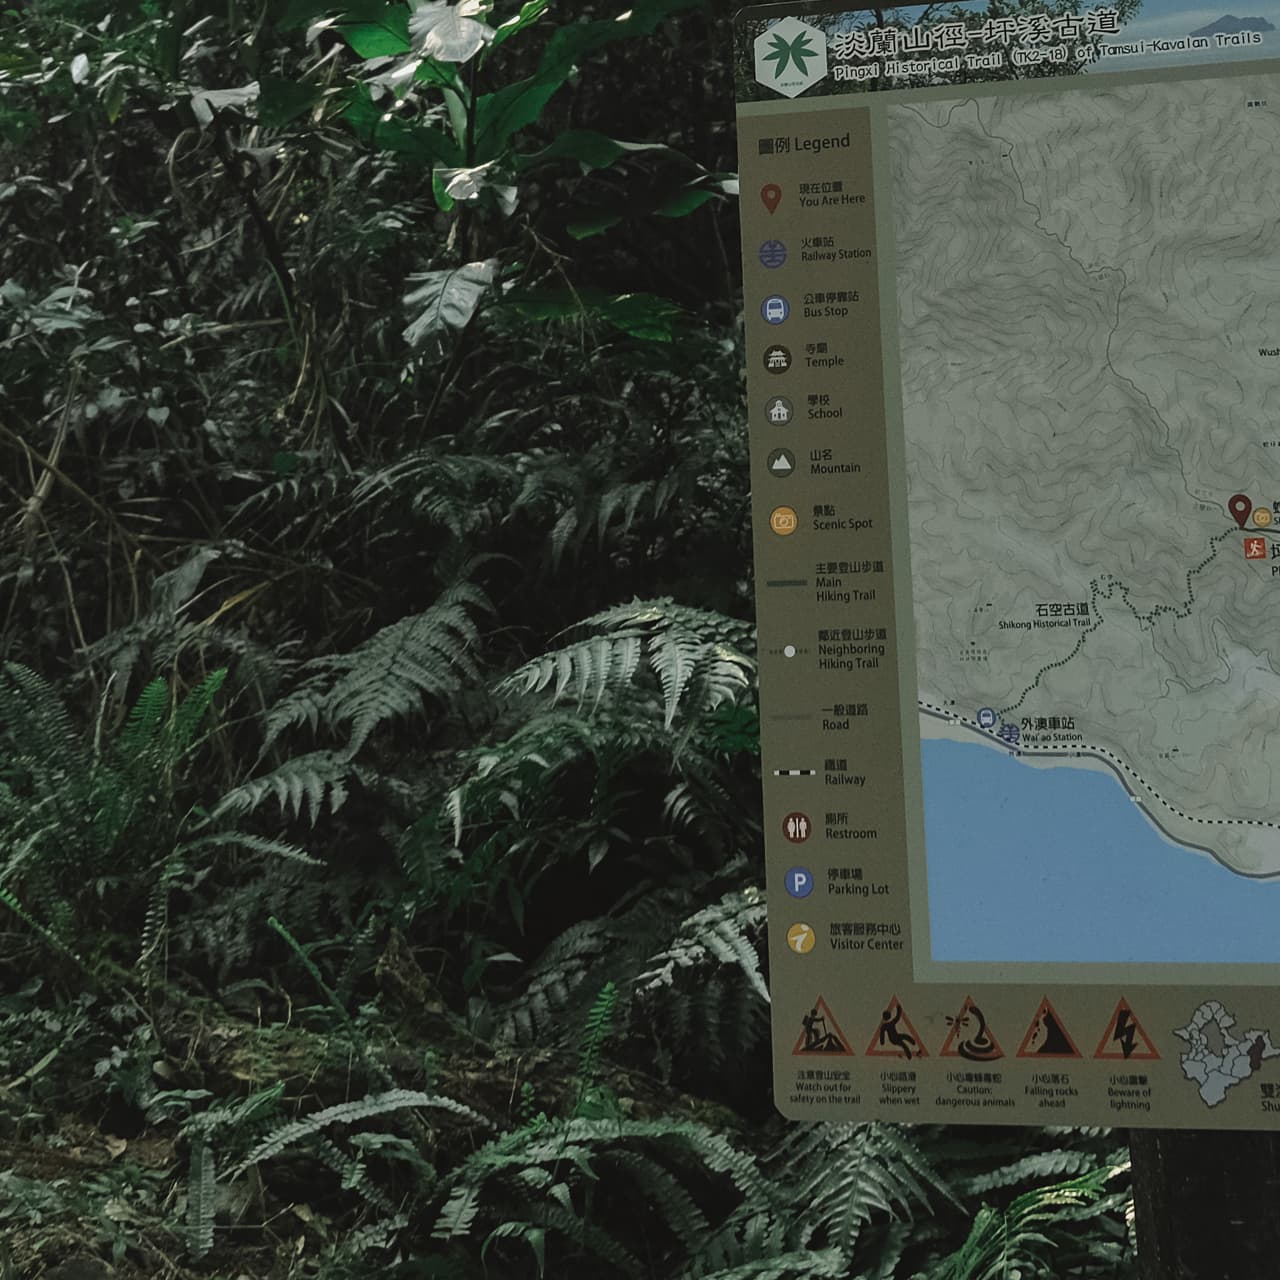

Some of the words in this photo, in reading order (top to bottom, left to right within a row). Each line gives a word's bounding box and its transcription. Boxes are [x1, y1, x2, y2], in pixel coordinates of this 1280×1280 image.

[835, 7, 1121, 60] 淡蘭山徑-坪溪古道
[835, 62, 880, 82] Pingxi
[885, 56, 961, 77] Historical
[967, 53, 1003, 70] Trail
[1012, 46, 1069, 67] (TK2-18)
[1077, 44, 1093, 60] of
[1099, 35, 1210, 57] Tamsui-Kavalan
[1216, 30, 1262, 48] Trails
[795, 133, 851, 155] Legend
[799, 196, 820, 208] You
[821, 195, 839, 206] Are
[841, 193, 865, 205] Here
[801, 236, 835, 249] 火車站
[801, 249, 836, 262] Railway
[838, 247, 872, 260] Station
[803, 307, 822, 318] Bus
[824, 305, 849, 318] Stop
[805, 355, 845, 368] Temple
[807, 407, 843, 420] School
[810, 449, 833, 462] 山名
[810, 463, 861, 475] Mountain
[813, 519, 846, 530] Scenic
[849, 518, 873, 531] Spot
[815, 560, 884, 575] 主要登山步道
[815, 577, 842, 588] Main
[816, 590, 850, 603] Hiking
[853, 589, 876, 601] Trail
[1035, 602, 1090, 617] 石空古道
[999, 620, 1032, 631] Shikong
[1033, 619, 1073, 629] Historical
[1073, 618, 1091, 627] Trail
[818, 643, 885, 657] Neighboring
[819, 658, 853, 671] Hiking
[855, 657, 879, 668] Trail
[822, 719, 850, 731] Road
[1021, 716, 1075, 732] 外澳車站
[1053, 732, 1083, 742] Station
[825, 774, 866, 787] Railway
[826, 827, 877, 840] Restroom
[794, 873, 806, 892] P
[828, 883, 869, 897] Parking
[871, 883, 890, 895] Lot
[830, 938, 865, 951] Visitor
[867, 938, 904, 950] Center
[795, 1081, 822, 1092] Watch
[823, 1082, 839, 1092] out
[839, 1082, 852, 1092] for
[881, 1083, 917, 1096] Slippery
[1024, 1086, 1054, 1098] Falling
[1055, 1086, 1079, 1097] rocks
[1107, 1087, 1140, 1098] Beware
[1141, 1086, 1152, 1097] of
[789, 1093, 815, 1104] safety
[815, 1095, 828, 1104] on
[828, 1094, 843, 1104] the
[844, 1094, 861, 1104] trail
[879, 1095, 903, 1105] when
[904, 1096, 920, 1105] wet
[935, 1096, 981, 1108] dangerous
[982, 1096, 1016, 1108] animals
[1038, 1098, 1066, 1108] ahead
[1110, 1099, 1151, 1112] lightning
